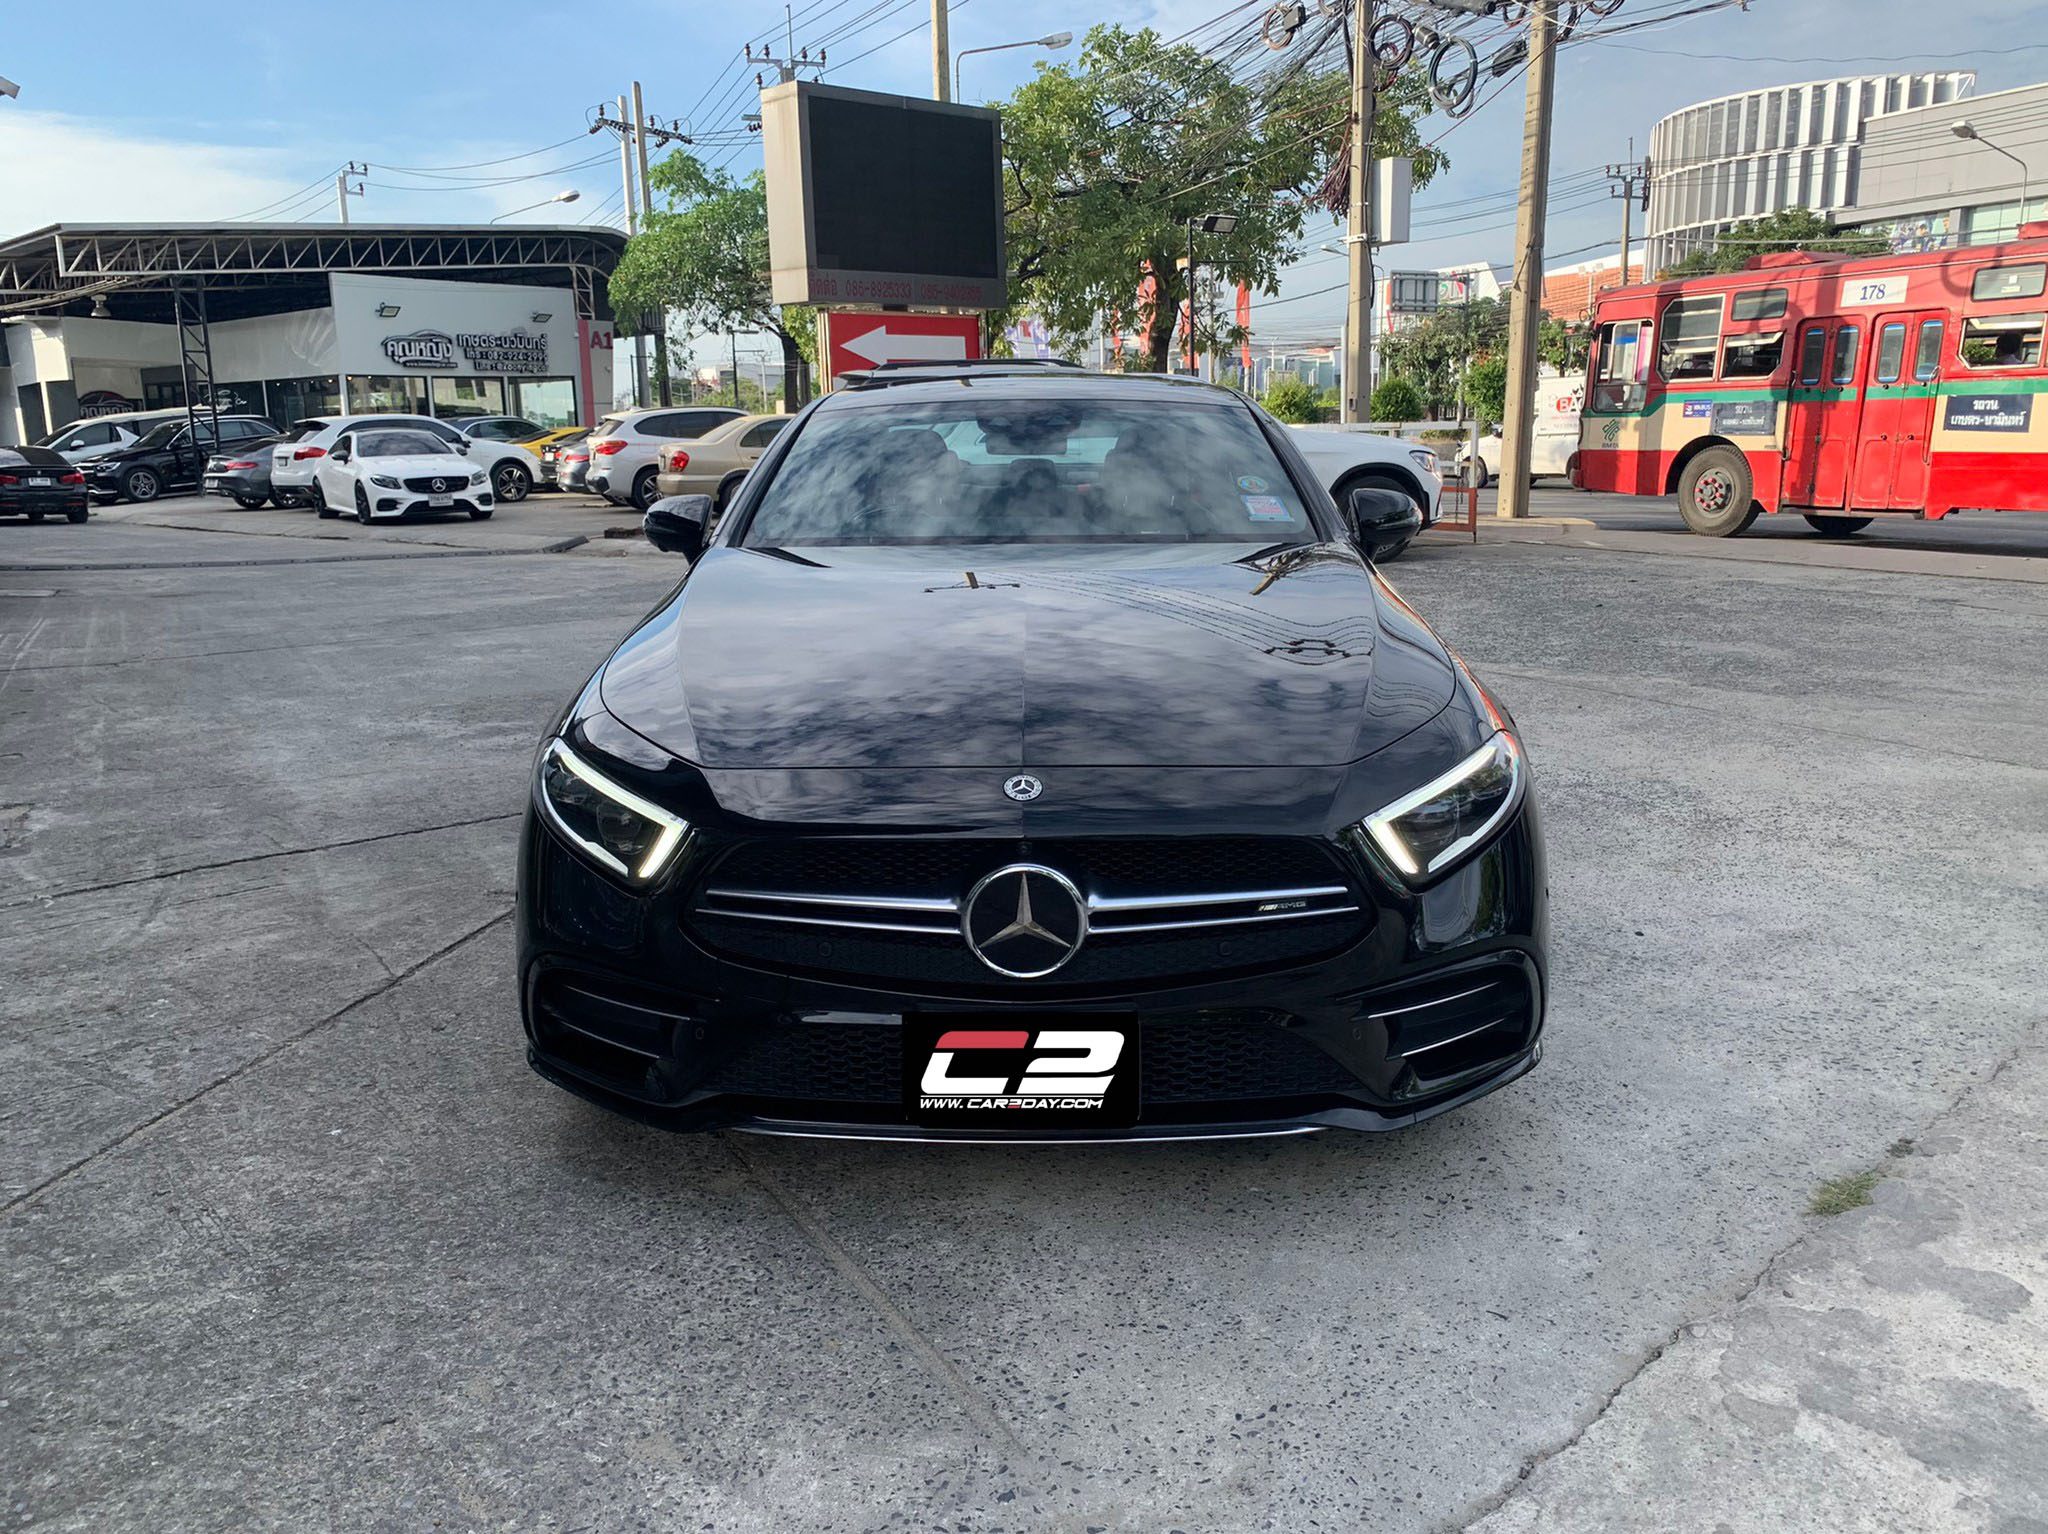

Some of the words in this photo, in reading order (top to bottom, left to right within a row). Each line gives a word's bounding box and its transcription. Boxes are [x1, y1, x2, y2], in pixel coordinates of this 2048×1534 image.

[1860, 283, 1886, 301] 178
[590, 331, 613, 350] A1
[386, 338, 453, 364] คุณหญิง
[1973, 399, 2000, 411] รถวน
